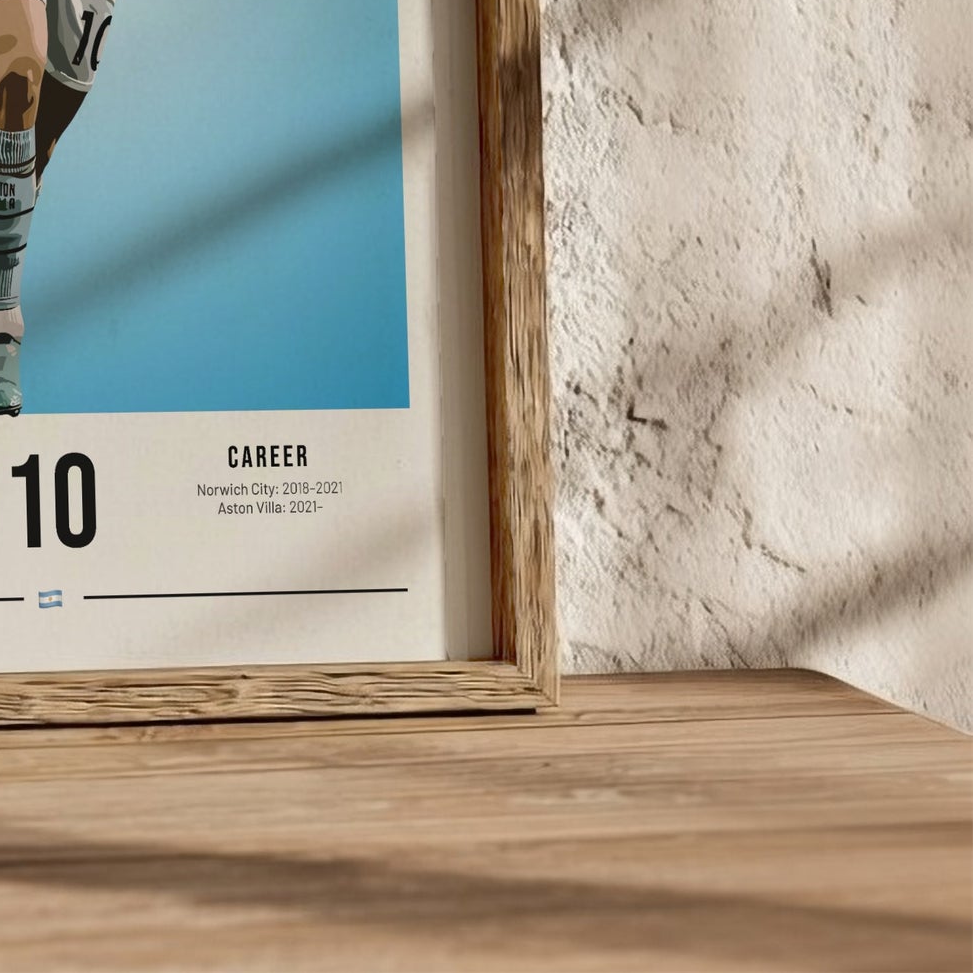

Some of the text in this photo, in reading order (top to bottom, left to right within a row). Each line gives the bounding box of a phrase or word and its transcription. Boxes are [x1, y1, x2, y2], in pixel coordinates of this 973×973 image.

[227, 445, 308, 469] CAREER
[11, 452, 97, 548] 10
[197, 483, 249, 496] Norwich
[251, 482, 279, 498] City:
[217, 502, 254, 515] Aston
[256, 501, 286, 514] Villa:
